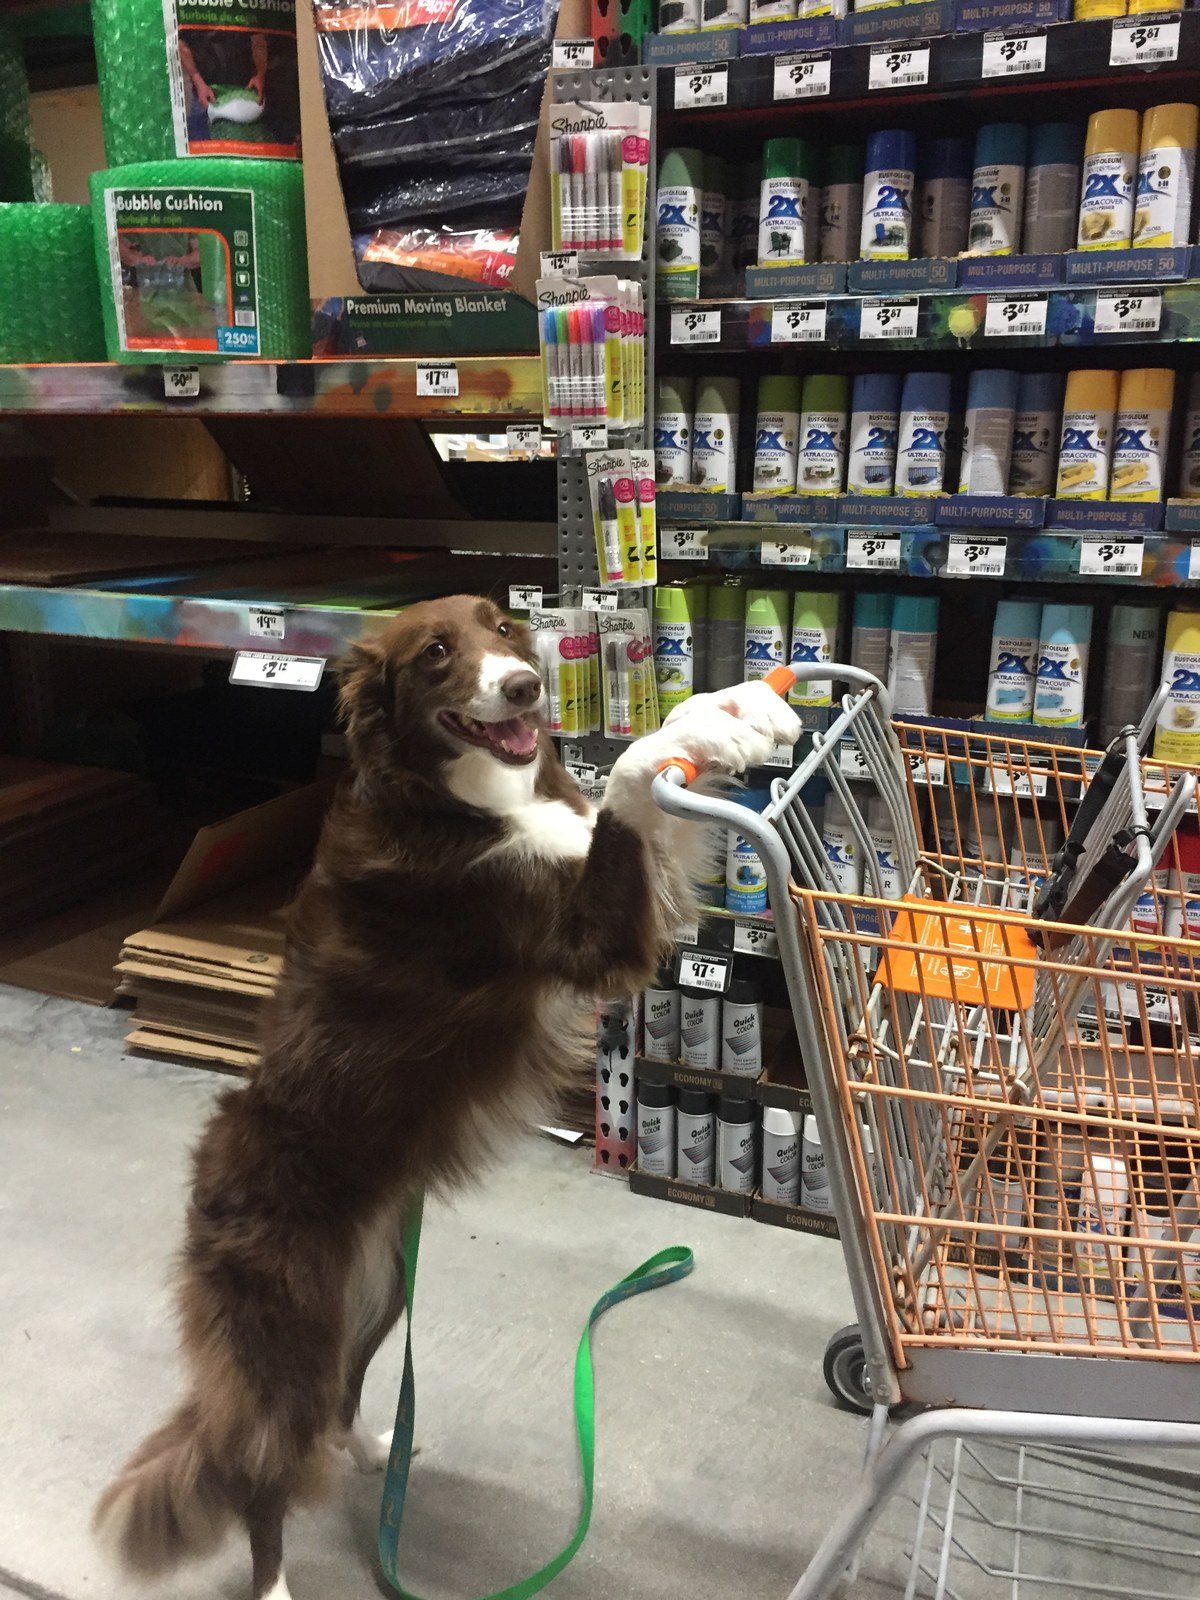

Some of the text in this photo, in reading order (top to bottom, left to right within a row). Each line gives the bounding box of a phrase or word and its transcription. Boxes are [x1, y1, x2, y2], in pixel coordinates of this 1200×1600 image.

[962, 3, 1034, 20] MULTI-PURPOSE
[853, 12, 939, 35] MULTI-PURPOSE 50
[750, 27, 814, 44] MULTI-PURPOSE
[1129, 27, 1160, 49] $387
[714, 37, 728, 52] 50
[1000, 40, 1028, 61] $387
[885, 53, 912, 73] $387
[550, 113, 608, 140] Sharpie
[1085, 173, 1121, 199] 2X
[115, 195, 223, 212] Bubble Cushion
[876, 185, 910, 209] 2X
[658, 203, 687, 225] 2X
[769, 194, 800, 218] 2X
[861, 266, 946, 280] MULTI-PURPOSE 50
[968, 262, 1037, 276] MULTI-PURPOSE
[1071, 257, 1175, 274] MULTI-PURPOSE 50
[753, 273, 833, 288] MULTI-PURPOSE 50
[347, 296, 507, 317] Premium Moving Blanket
[538, 288, 591, 313] Sharpie
[1113, 299, 1142, 319] $387
[1002, 303, 1029, 322] $387
[224, 331, 248, 345] 250
[756, 429, 784, 450] 2X
[806, 428, 838, 450] 2X
[911, 428, 944, 450] 2X
[1062, 427, 1095, 450] 2X
[1115, 427, 1148, 450] 2X
[587, 456, 625, 477] Sharpie
[704, 503, 717, 514] 50
[814, 505, 827, 516] 50
[841, 503, 927, 518] MULTI-PURPOSE 50
[939, 505, 1032, 519] MULTI-PURPOSE 50
[1057, 510, 1127, 522] MULTI-PURPOSE
[964, 546, 989, 563] $387
[1098, 545, 1126, 562] $387
[530, 617, 567, 631] Sharpie
[598, 618, 635, 634] Sharpie
[655, 636, 684, 656] 2X
[745, 640, 772, 659] 2X
[792, 642, 820, 662] 2X
[996, 652, 1030, 673] 2X
[1038, 656, 1068, 679] 2X
[805, 715, 817, 724] 50
[650, 999, 672, 1012] Quick
[653, 1008, 671, 1019] COLOR
[684, 1009, 704, 1020] Quick
[686, 1017, 704, 1027] COLOR
[733, 1013, 755, 1028] Quick
[736, 1022, 755, 1035] COLOR
[674, 1072, 712, 1087] ECONOMY
[641, 1117, 661, 1128] Quick
[644, 1124, 660, 1135] COLOR
[691, 1123, 711, 1138] Quick
[694, 1130, 712, 1145] COLOR
[740, 1132, 754, 1148] Qui
[776, 1142, 797, 1158] Quick
[779, 1149, 798, 1164] COLOR
[667, 1187, 706, 1204] ECONOMY
[786, 1214, 826, 1232] ECONOMY
